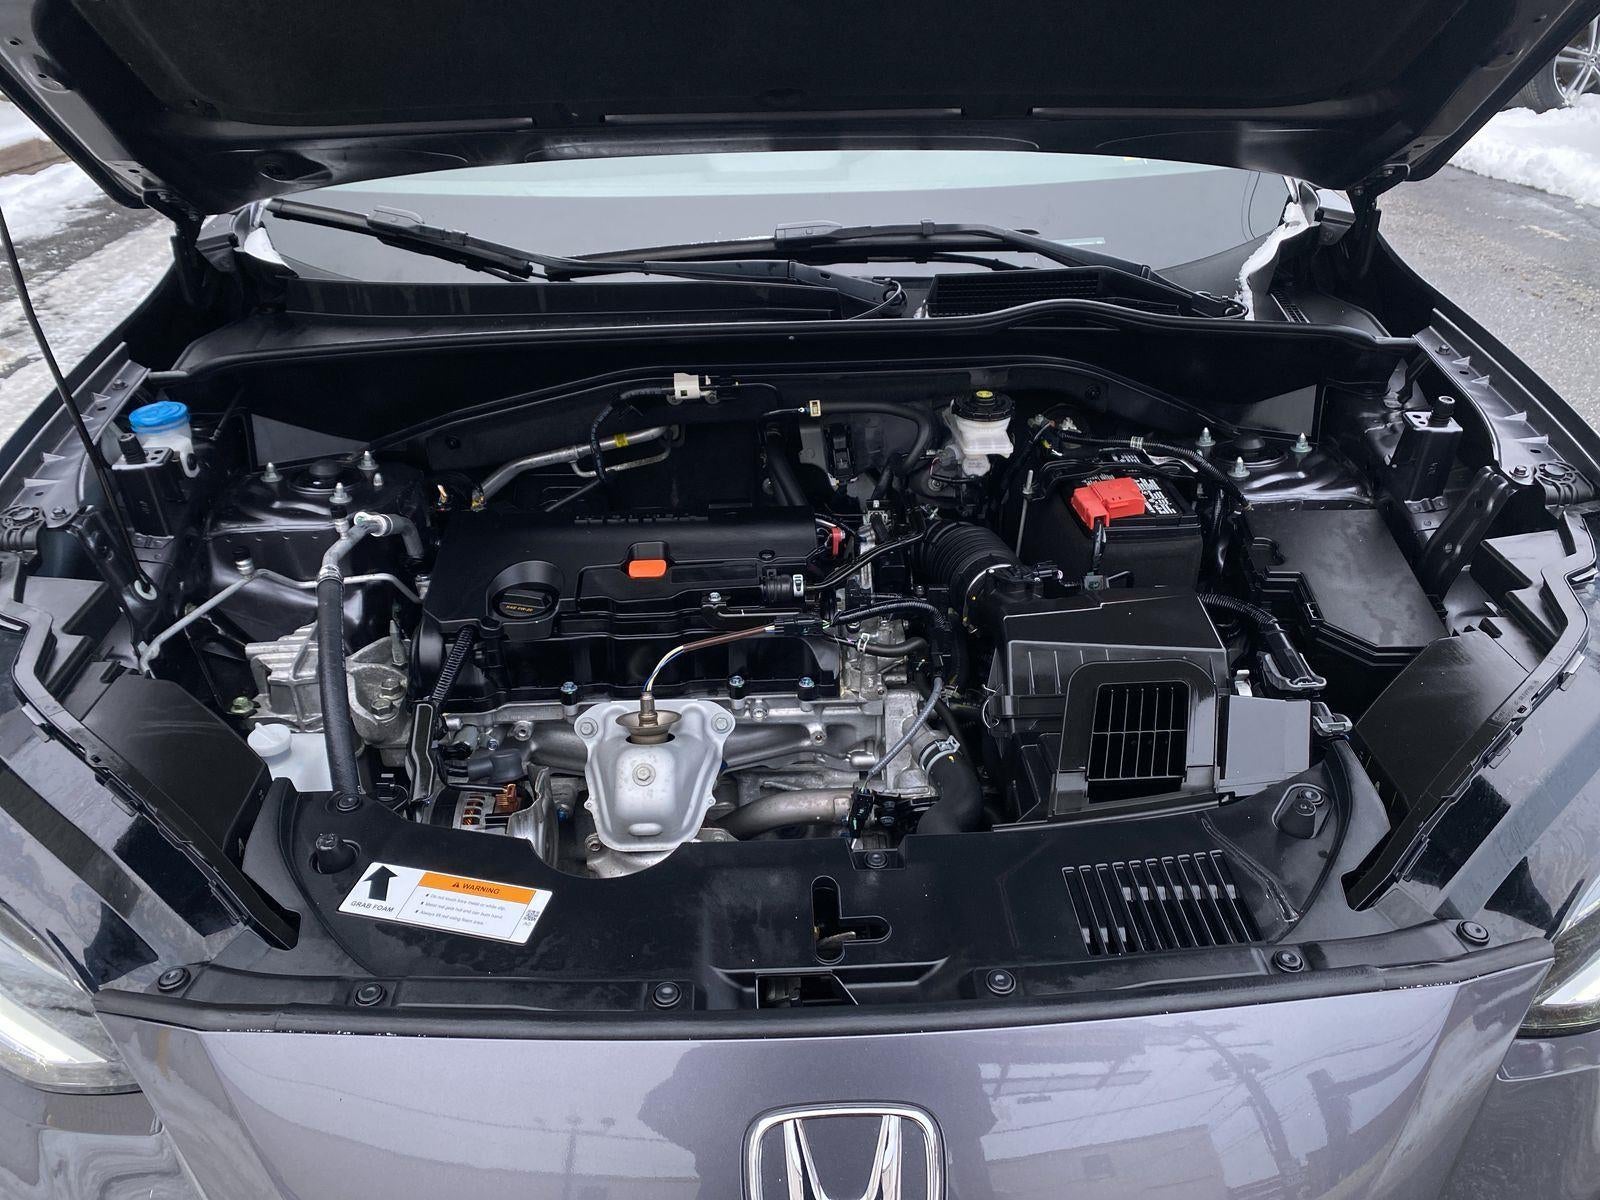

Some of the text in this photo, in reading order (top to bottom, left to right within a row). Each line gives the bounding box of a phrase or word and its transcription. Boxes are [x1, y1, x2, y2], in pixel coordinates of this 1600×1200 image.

[462, 883, 501, 895] WARNING
[351, 900, 394, 913] GRAB FOAM
